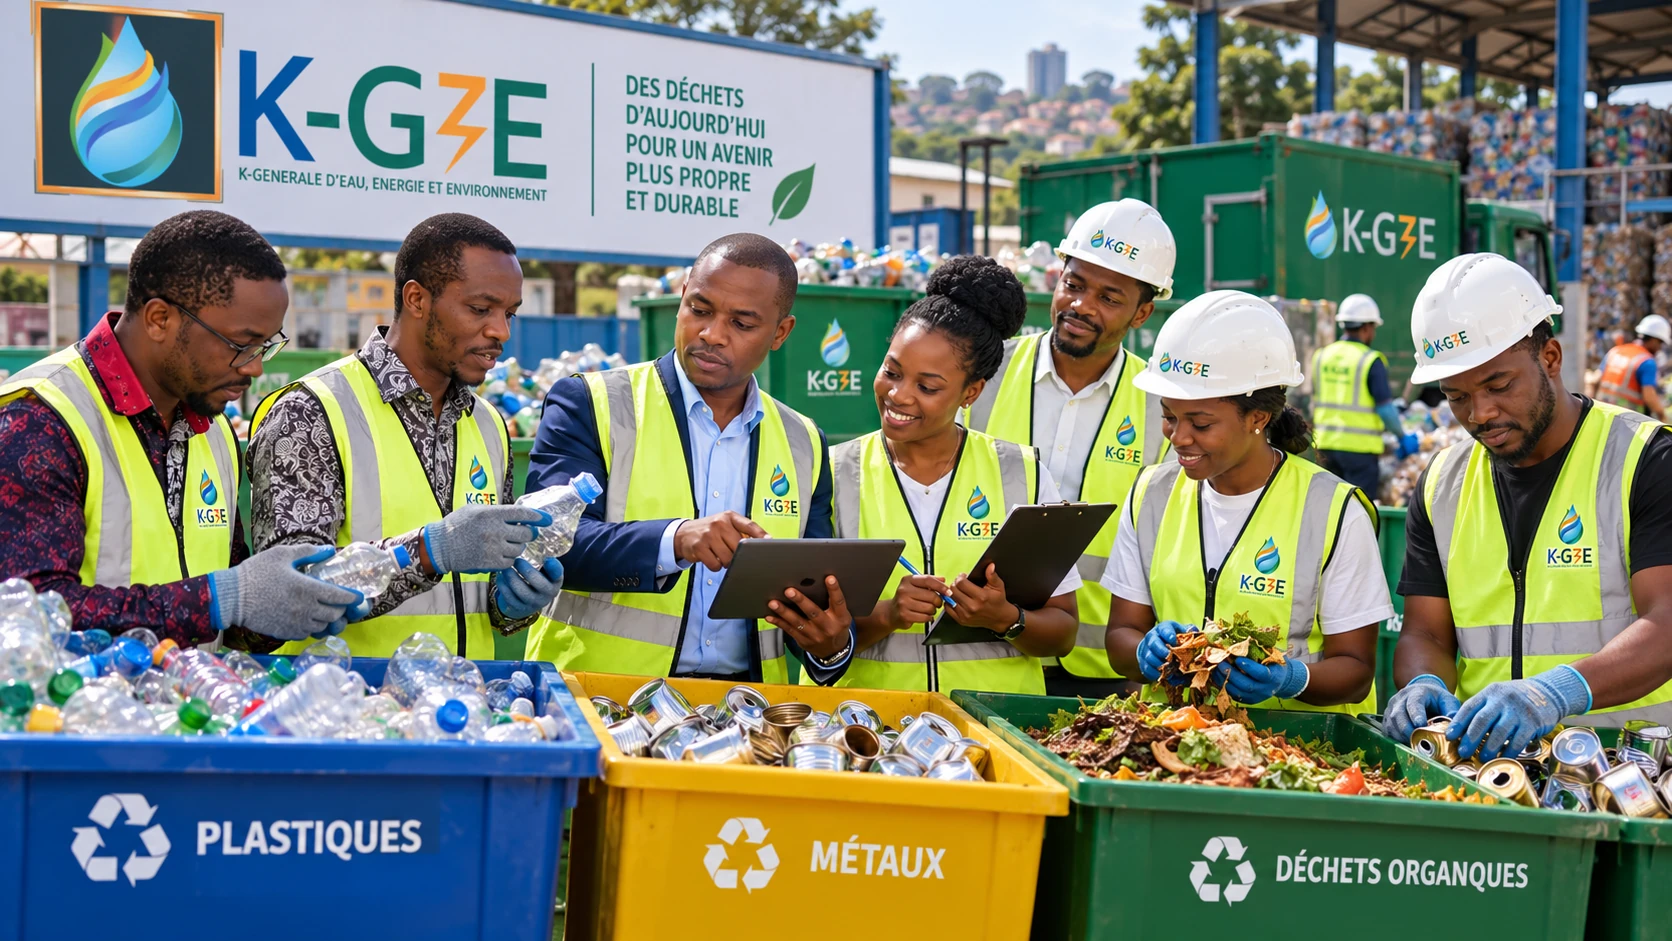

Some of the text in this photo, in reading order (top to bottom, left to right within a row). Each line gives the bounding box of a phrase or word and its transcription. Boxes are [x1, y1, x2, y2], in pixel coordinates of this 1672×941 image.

[626, 75, 744, 108] DES DÉCHETS
[626, 104, 765, 139] D'AUJOURD'HUI
[626, 133, 773, 167] POUR UN AVENIR
[239, 167, 547, 201] K-GENERALE D'EAU, ENERGIE ET ENVIRONNEMENT
[626, 162, 751, 192] PLUS PROPRE
[626, 190, 739, 218] ET DURABLE
[197, 819, 422, 861] PLASTIQUES
[810, 834, 946, 879] MÉTAUX
[1276, 849, 1529, 892] DÉCHETS ORGANQUES
